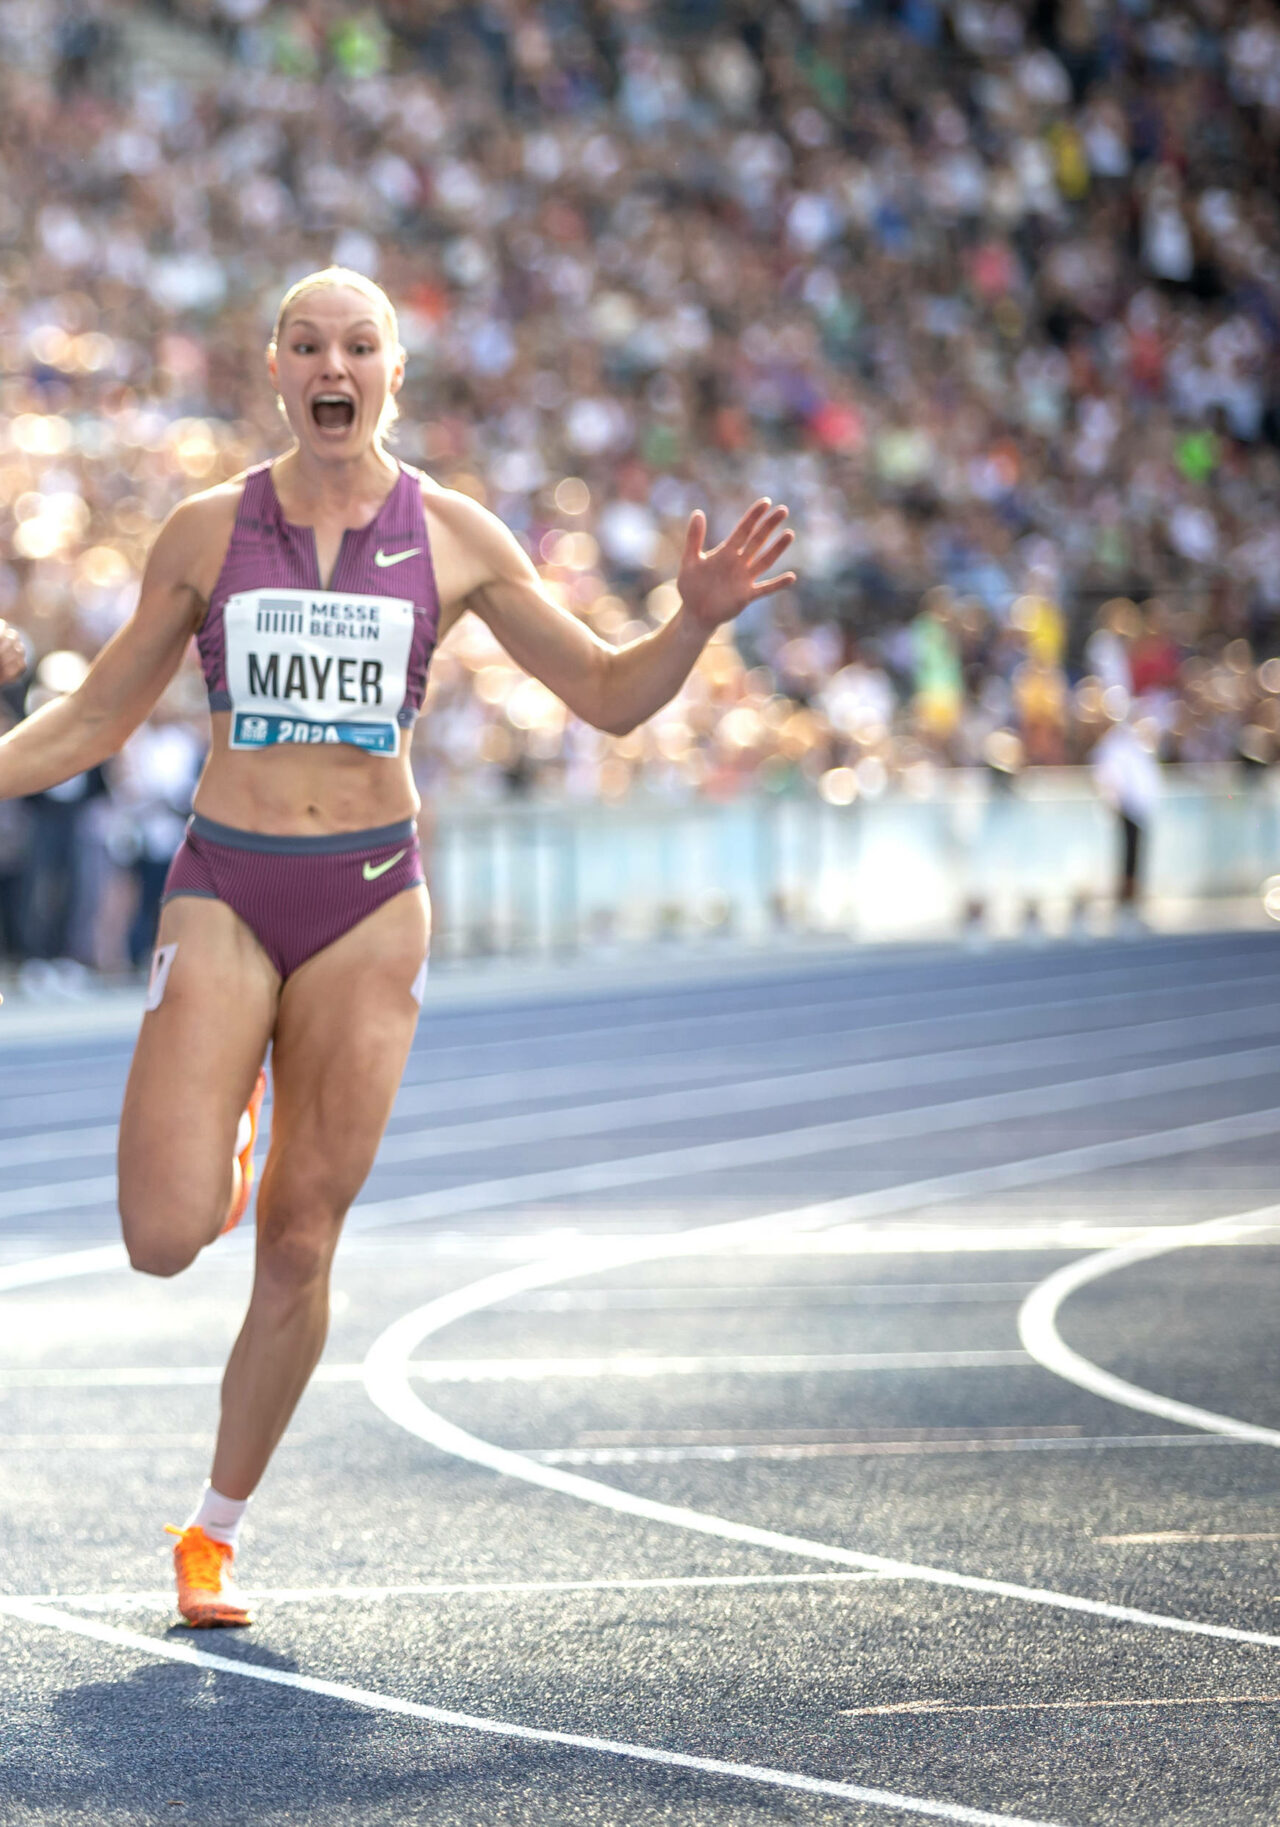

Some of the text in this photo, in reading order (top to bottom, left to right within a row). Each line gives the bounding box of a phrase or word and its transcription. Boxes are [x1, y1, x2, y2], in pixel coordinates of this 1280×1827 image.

[311, 602, 380, 622] MESSE
[311, 621, 380, 640] BERLIN
[248, 652, 383, 705] MAYER
